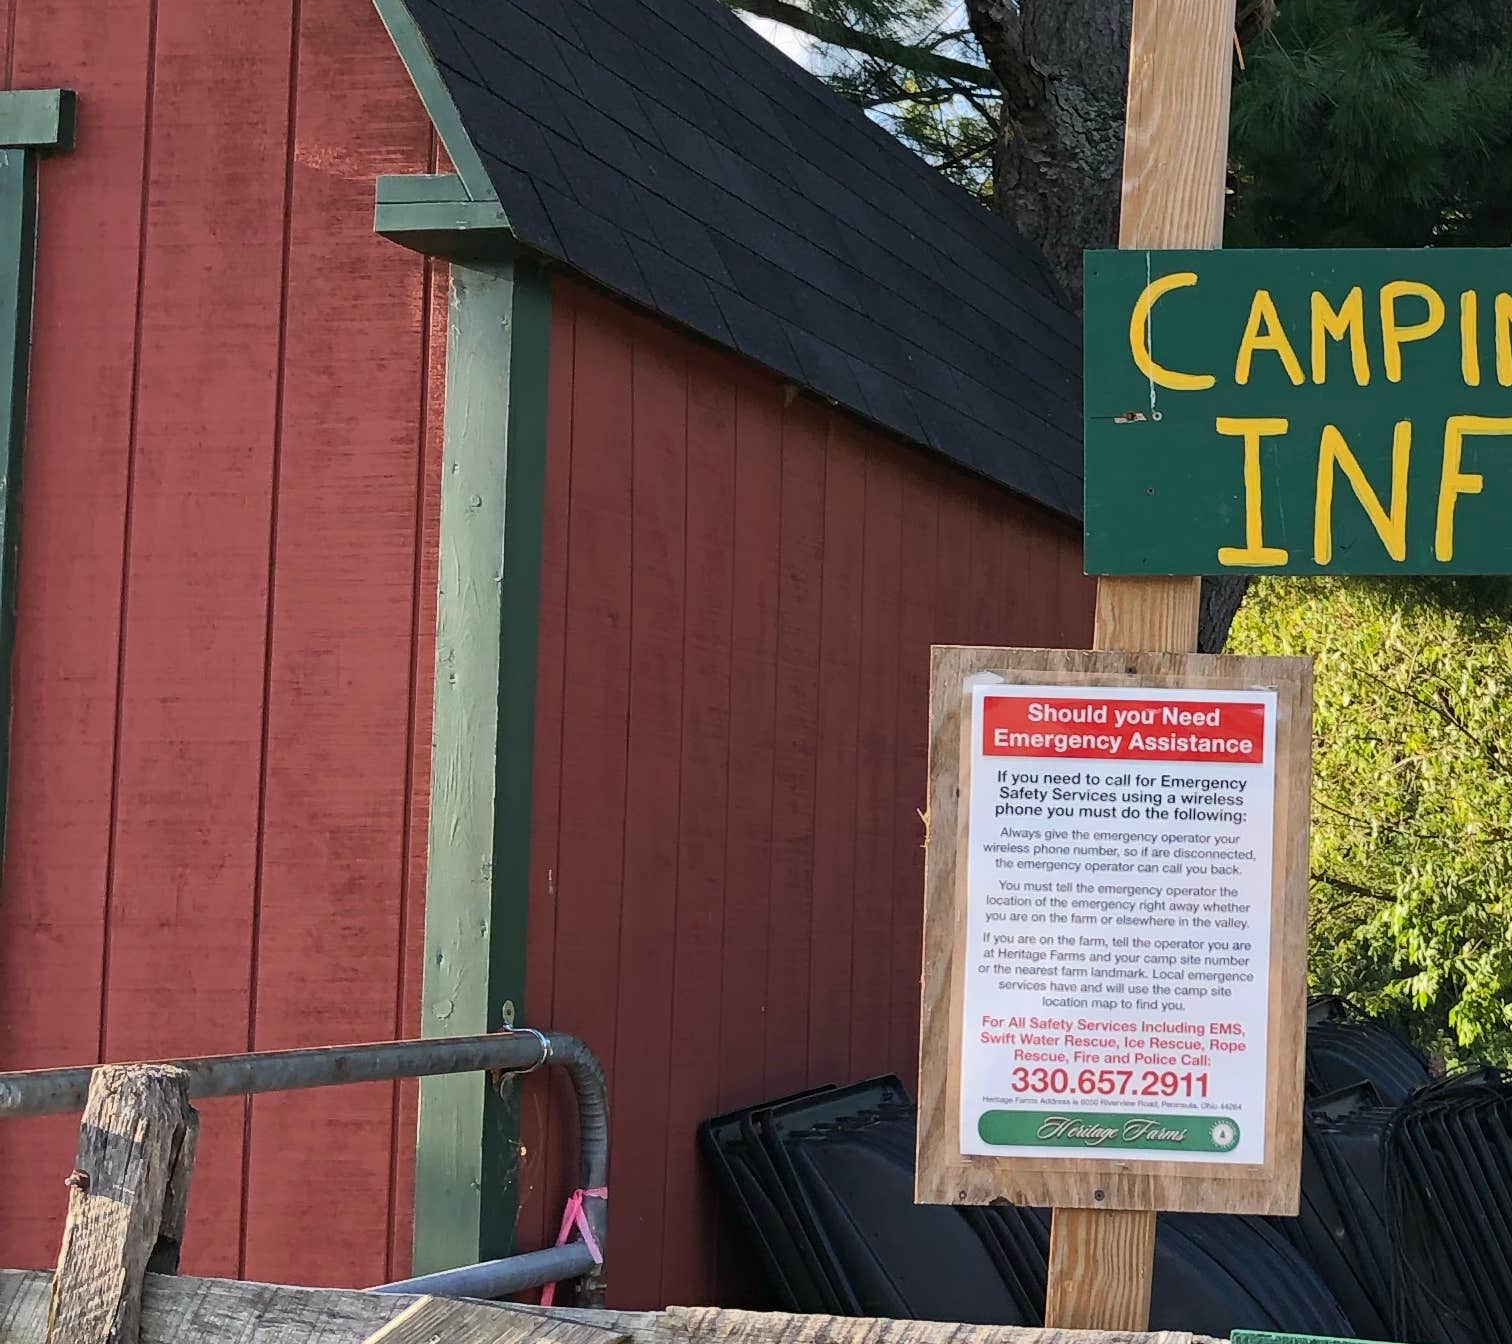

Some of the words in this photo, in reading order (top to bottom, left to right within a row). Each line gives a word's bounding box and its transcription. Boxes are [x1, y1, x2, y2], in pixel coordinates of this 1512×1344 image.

[1027, 702, 1107, 723] Should
[1114, 708, 1154, 726] you
[1162, 706, 1220, 726] Need
[993, 728, 1122, 753] Emergency
[1128, 731, 1252, 753] Assistance
[997, 770, 1007, 782] If
[1011, 773, 1038, 785] you
[1043, 772, 1080, 784] need
[1085, 773, 1100, 785] to
[1104, 773, 1130, 786] call
[1135, 774, 1156, 786] for
[1160, 774, 1247, 792] Emergency
[999, 785, 1047, 802] Safety
[1052, 787, 1116, 801] Services
[1121, 790, 1161, 806] using
[1166, 794, 1175, 803] a
[1180, 791, 1243, 805] wireless
[995, 802, 1042, 817] phone
[1047, 806, 1073, 818] you
[1078, 806, 1116, 818] must
[1121, 806, 1140, 818] do
[1144, 806, 1168, 819] the
[1174, 807, 1246, 824] following:
[999, 826, 1041, 840] Always
[1044, 828, 1068, 841] give
[1071, 829, 1089, 840] the
[1093, 831, 1158, 844] emergency
[1160, 833, 1211, 844] operator
[1214, 835, 1240, 846] your
[983, 842, 1029, 853] wireless
[1032, 843, 1069, 856] phone
[1073, 845, 1119, 857] number,
[1123, 848, 1137, 856] so
[1141, 846, 1148, 856] if
[1151, 848, 1170, 857] are
[1173, 847, 1255, 861] disconnected,
[995, 857, 1013, 868] the
[1016, 860, 1081, 872] emergency
[1084, 861, 1135, 873] operator
[1136, 863, 1158, 872] can
[1162, 862, 1182, 873] call
[1185, 865, 1207, 876] you
[1210, 863, 1241, 875] back.
[998, 879, 1020, 890] You
[1023, 881, 1052, 892] must
[1055, 882, 1072, 892] tell
[1076, 882, 1094, 893] the
[1097, 885, 1163, 897] emergency
[1165, 885, 1216, 897] operator
[1219, 886, 1238, 897] the
[986, 894, 1031, 906] location
[1034, 896, 1046, 906] of
[1049, 897, 1067, 908] the
[1071, 899, 1136, 912] emergency
[1138, 899, 1165, 912] right
[1168, 902, 1199, 914] away
[1202, 901, 1250, 912] whether
[985, 912, 1006, 922] you
[1009, 912, 1027, 921] are
[1031, 913, 1046, 922] on
[1049, 911, 1067, 923] the
[1070, 912, 1097, 924] farm
[1100, 915, 1113, 924] or
[1115, 914, 1174, 926] elsewhere
[1178, 916, 1188, 926] in
[1192, 916, 1211, 927] the
[1214, 917, 1249, 930] valley.
[983, 931, 990, 942] If
[993, 934, 1014, 945] you
[1017, 935, 1036, 943] are
[1038, 936, 1054, 945] on
[1056, 934, 1075, 945] the
[1079, 935, 1108, 948] farm,
[1112, 936, 1128, 947] tell
[1132, 936, 1150, 948] the
[1153, 938, 1204, 950] operator
[1207, 941, 1228, 952] you
[1232, 941, 1251, 951] are
[983, 948, 994, 957] at
[997, 947, 1046, 962] Heritage
[1050, 949, 1086, 961] Farms
[1088, 951, 1111, 961] and
[1114, 954, 1140, 965] your
[1143, 954, 1177, 966] camp
[1180, 954, 1201, 964] site
[1204, 955, 1249, 966] number
[977, 964, 990, 972] or
[993, 963, 1011, 974] the
[1014, 966, 1057, 976] nearest
[1061, 965, 1087, 976] farm
[1090, 967, 1148, 978] landmark.
[1152, 968, 1184, 979] Local
[1187, 971, 1253, 983] emergence
[998, 979, 1046, 991] services
[1049, 980, 1077, 992] have
[1079, 981, 1102, 993] and
[1105, 982, 1124, 993] will
[1127, 985, 1149, 994] use
[1151, 983, 1171, 995] the
[1173, 986, 1207, 998] camp
[1210, 985, 1231, 996] site
[1042, 995, 1087, 1008] location
[1091, 999, 1118, 1011] map
[1119, 998, 1132, 1009] to
[1135, 998, 1158, 1010] find
[1160, 1001, 1185, 1012] you.
[982, 1015, 1005, 1027] For
[1007, 1016, 1025, 1028] All
[1029, 1016, 1073, 1032] Safety
[1077, 1018, 1137, 1032] Services
[1141, 1020, 1205, 1037] Including
[1209, 1022, 1244, 1036] EMS,
[980, 1031, 1015, 1044] Swift
[1019, 1033, 1059, 1045] Water
[1064, 1034, 1119, 1049] Rescue,
[1124, 1036, 1145, 1048] Ice
[1149, 1036, 1204, 1051] Rescue,
[1209, 1038, 1246, 1053] Rope
[1014, 1048, 1069, 1064] Rescue,
[1073, 1050, 1100, 1063] Fire
[1103, 1052, 1129, 1063] and
[1134, 1052, 1176, 1065] Police
[1180, 1053, 1210, 1066] Call:
[1011, 1066, 1207, 1097] 330.657.2911
[1036, 1116, 1119, 1146] Heritage
[1121, 1118, 1187, 1142] Farms
